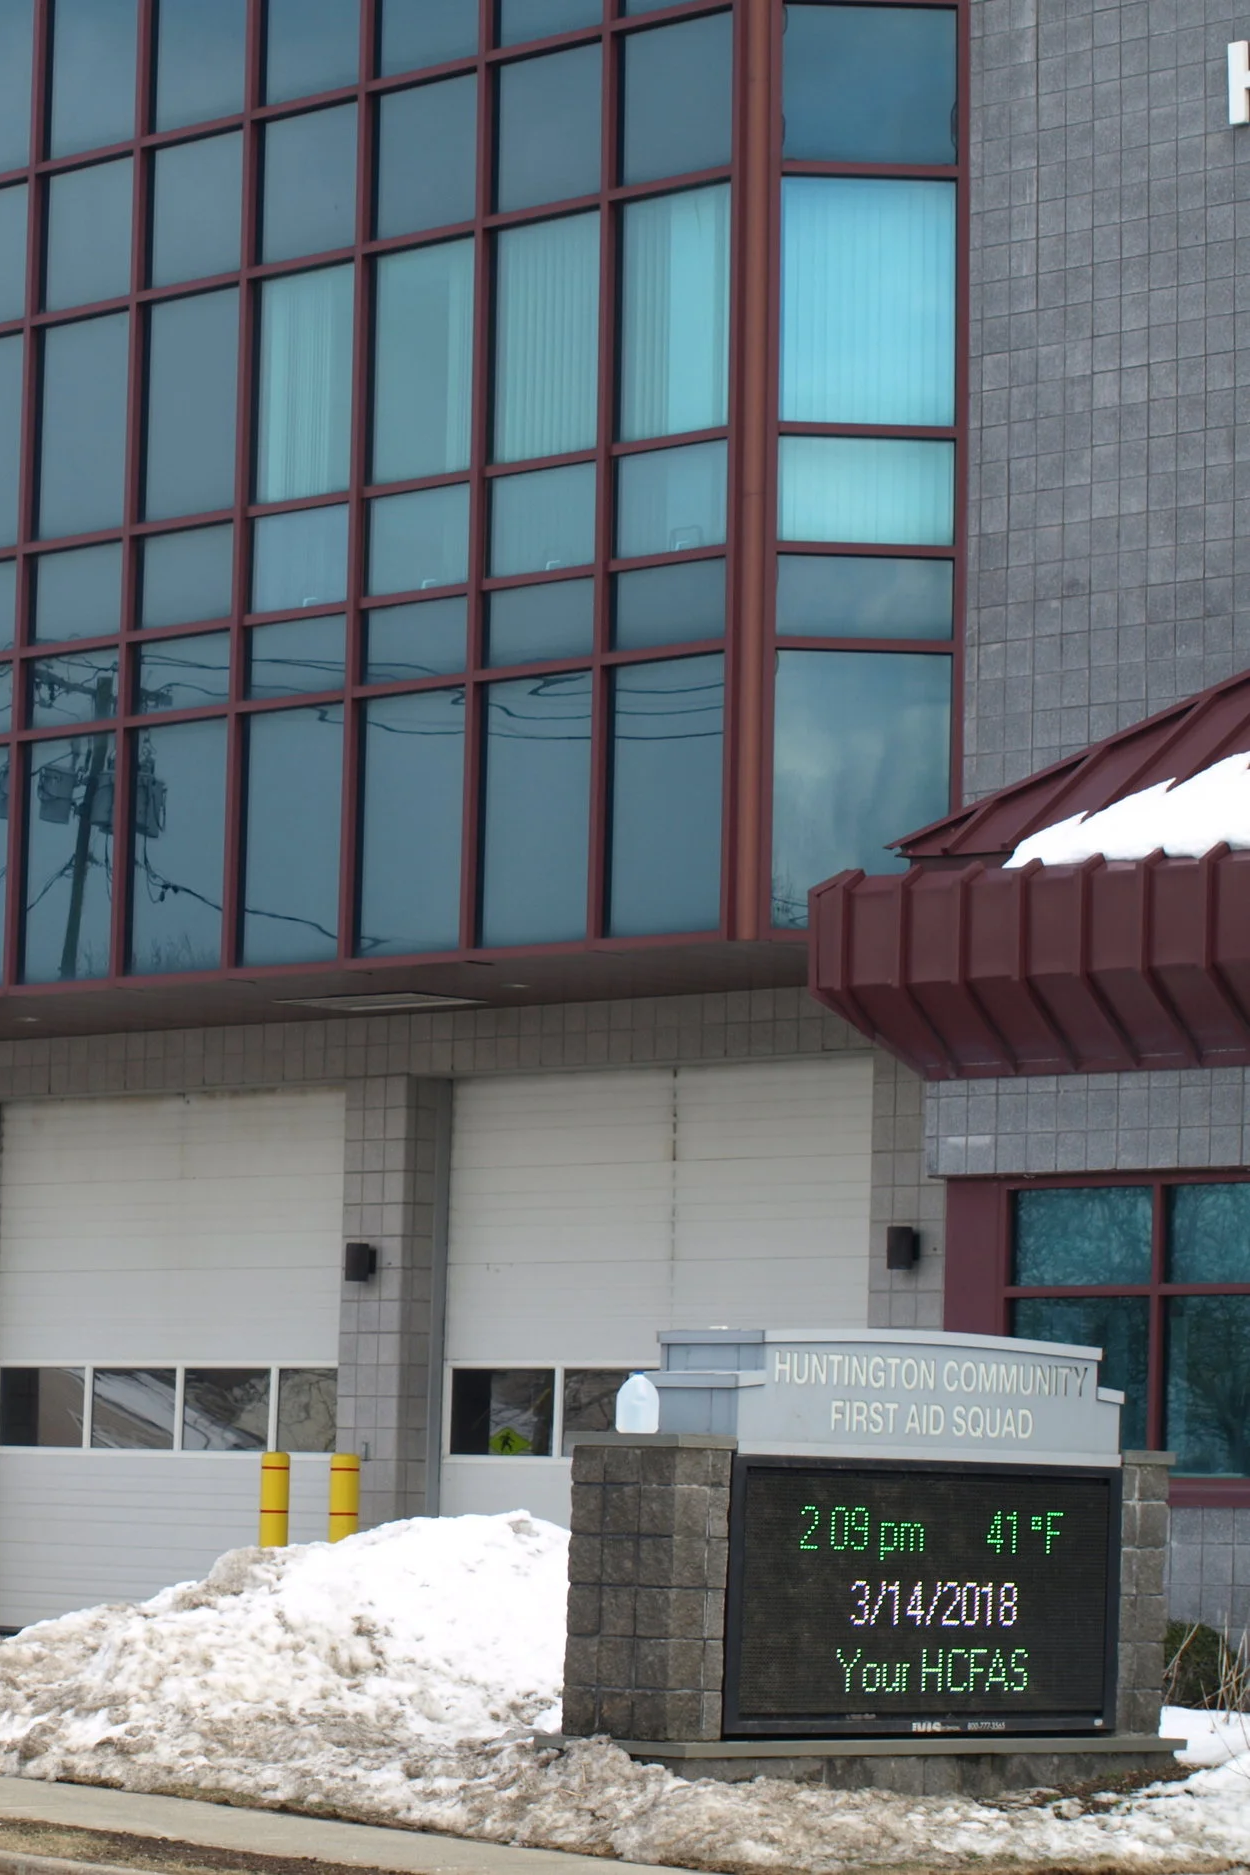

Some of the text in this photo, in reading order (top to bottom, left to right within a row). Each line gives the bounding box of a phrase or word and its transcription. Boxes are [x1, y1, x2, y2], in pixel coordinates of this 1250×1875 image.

[774, 1350, 1088, 1398] HUNTINGTON COMMUNITY
[830, 1400, 1033, 1439] FIRST AID SQUAD
[879, 1521, 925, 1561] pm
[986, 1510, 1018, 1554] 41
[850, 1580, 1018, 1627] 3/14/2018
[836, 1648, 1029, 1693] Your HCFAS
